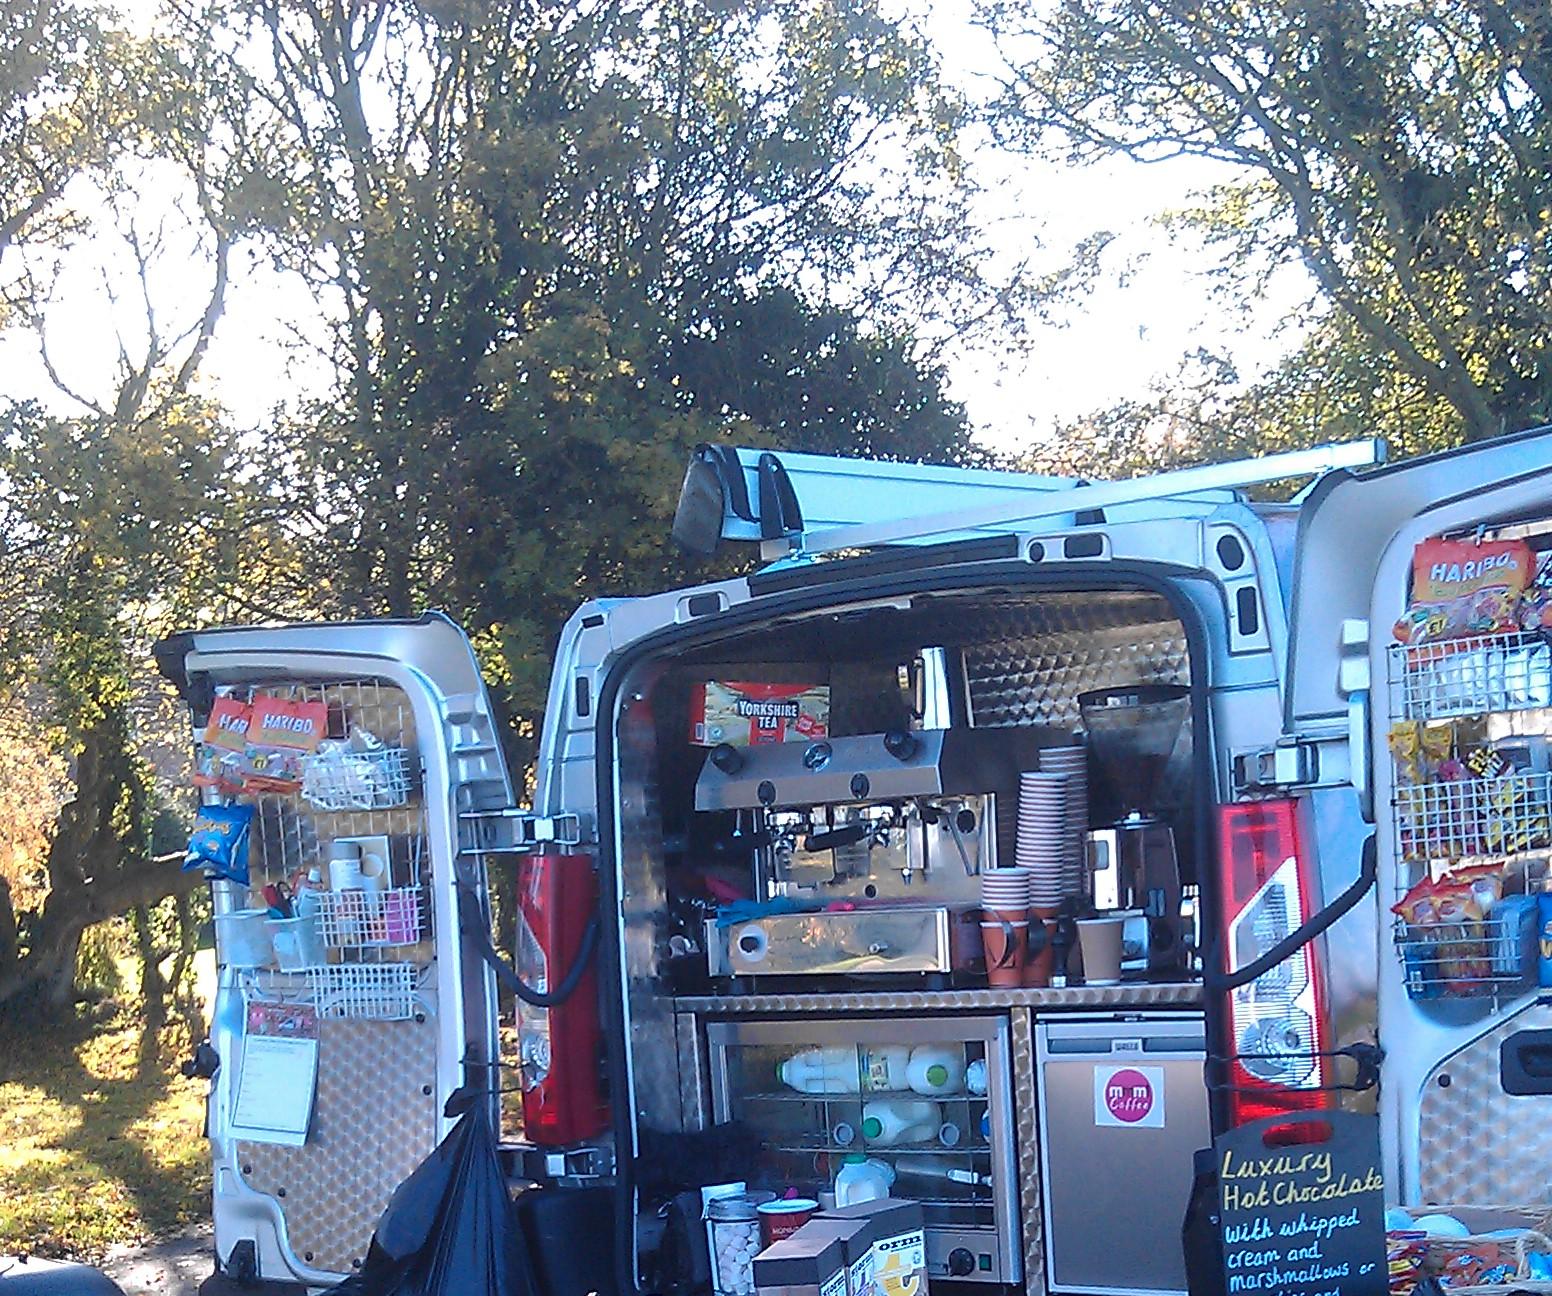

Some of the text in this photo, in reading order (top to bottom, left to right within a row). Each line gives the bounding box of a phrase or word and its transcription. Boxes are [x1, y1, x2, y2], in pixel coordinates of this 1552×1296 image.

[1430, 551, 1510, 583] HARIBO
[738, 700, 798, 717] YORKSHIRE
[218, 713, 249, 734] HAR
[262, 713, 313, 733] HARIBO
[758, 715, 778, 729] TEA
[1109, 1096, 1149, 1112] Coffee
[1221, 1151, 1332, 1184] Luxury
[1279, 1207, 1361, 1238] whipped
[879, 1235, 922, 1251] orm
[1227, 1241, 1323, 1269] cream and
[1359, 1263, 1376, 1275] or
